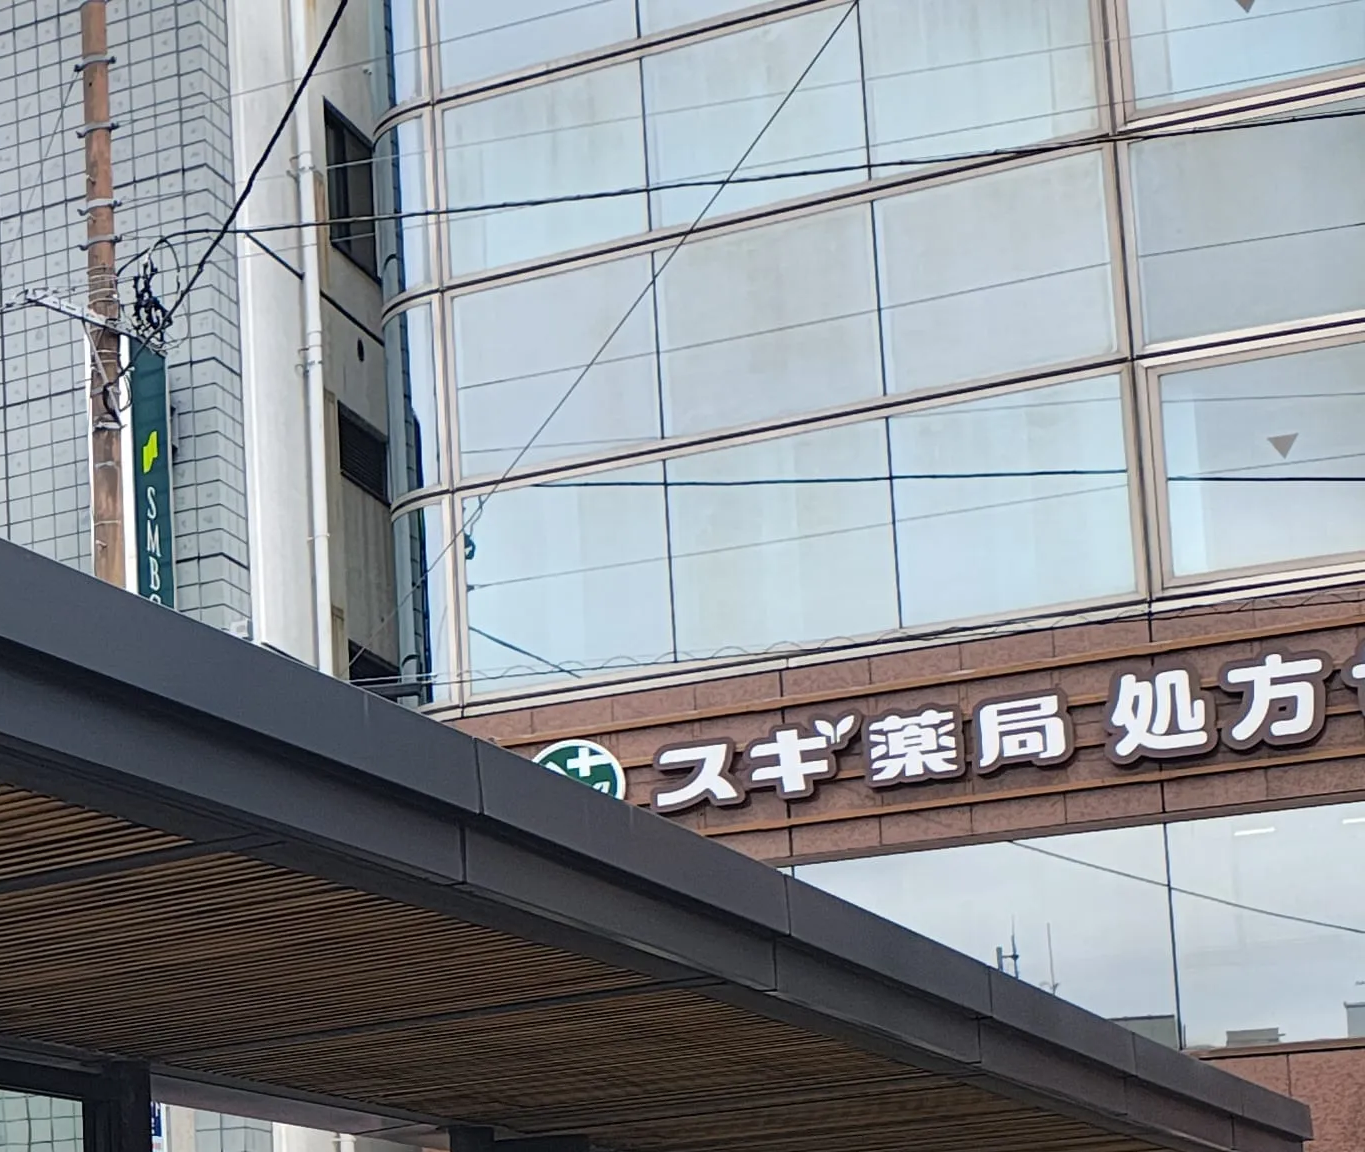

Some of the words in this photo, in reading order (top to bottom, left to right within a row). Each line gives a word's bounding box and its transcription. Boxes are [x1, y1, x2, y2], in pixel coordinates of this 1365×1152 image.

[655, 693, 1069, 808] スギ薬局
[1111, 653, 1365, 755] 処方
